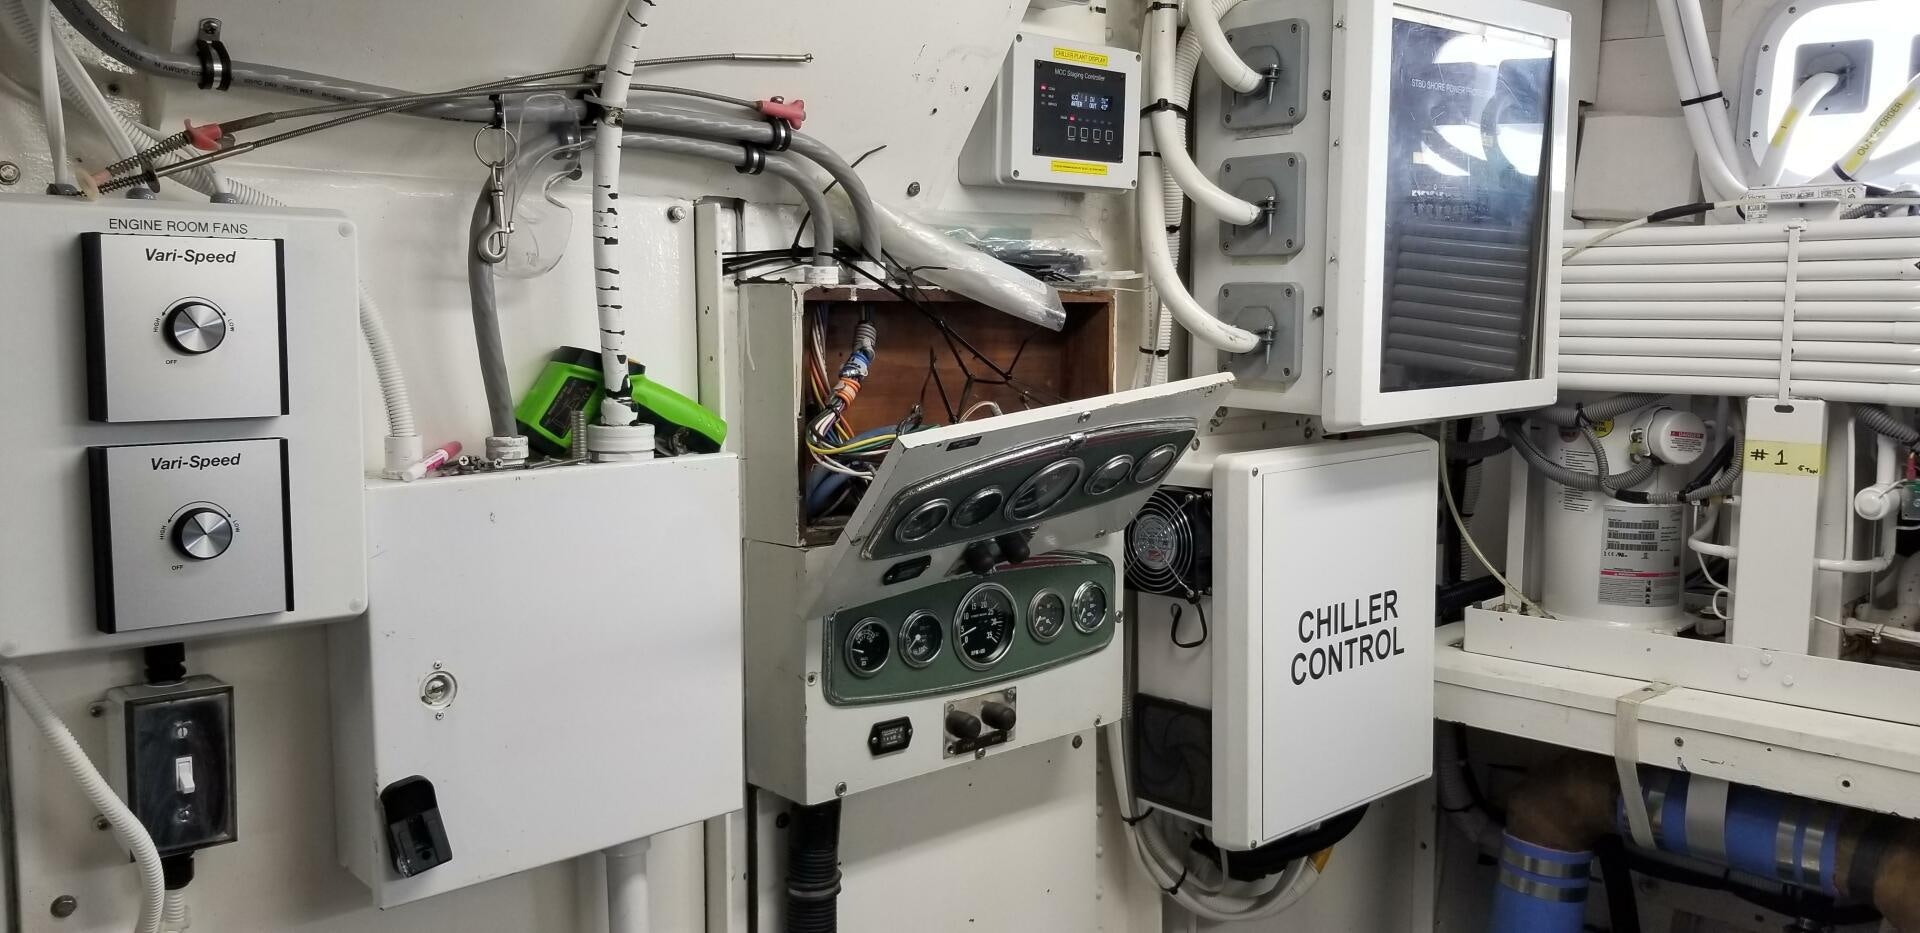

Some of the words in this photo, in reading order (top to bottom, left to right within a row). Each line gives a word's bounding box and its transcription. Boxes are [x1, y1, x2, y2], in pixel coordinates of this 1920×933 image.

[1074, 53, 1087, 61] PLANT
[1067, 69, 1083, 79] Staging
[1084, 73, 1105, 81] Controller
[1427, 80, 1445, 92] SHORE
[1446, 83, 1465, 94] POWER
[1879, 101, 1904, 127] ORDER
[109, 218, 163, 231] ENGINE
[167, 220, 209, 233] ROOM
[213, 222, 248, 235] FANS
[145, 247, 237, 265] Vari-Speed
[153, 317, 161, 333] HIGH
[227, 318, 235, 332] LOW
[150, 452, 241, 471] Vari-Speed
[1774, 449, 1789, 466] 1
[159, 524, 167, 540] HIGH
[232, 519, 240, 533] LOW
[971, 602, 977, 610] 15
[963, 612, 969, 620] 10
[1298, 589, 1398, 644] CHILLER
[964, 635, 969, 644] 0
[1290, 626, 1405, 686] CONTROL
